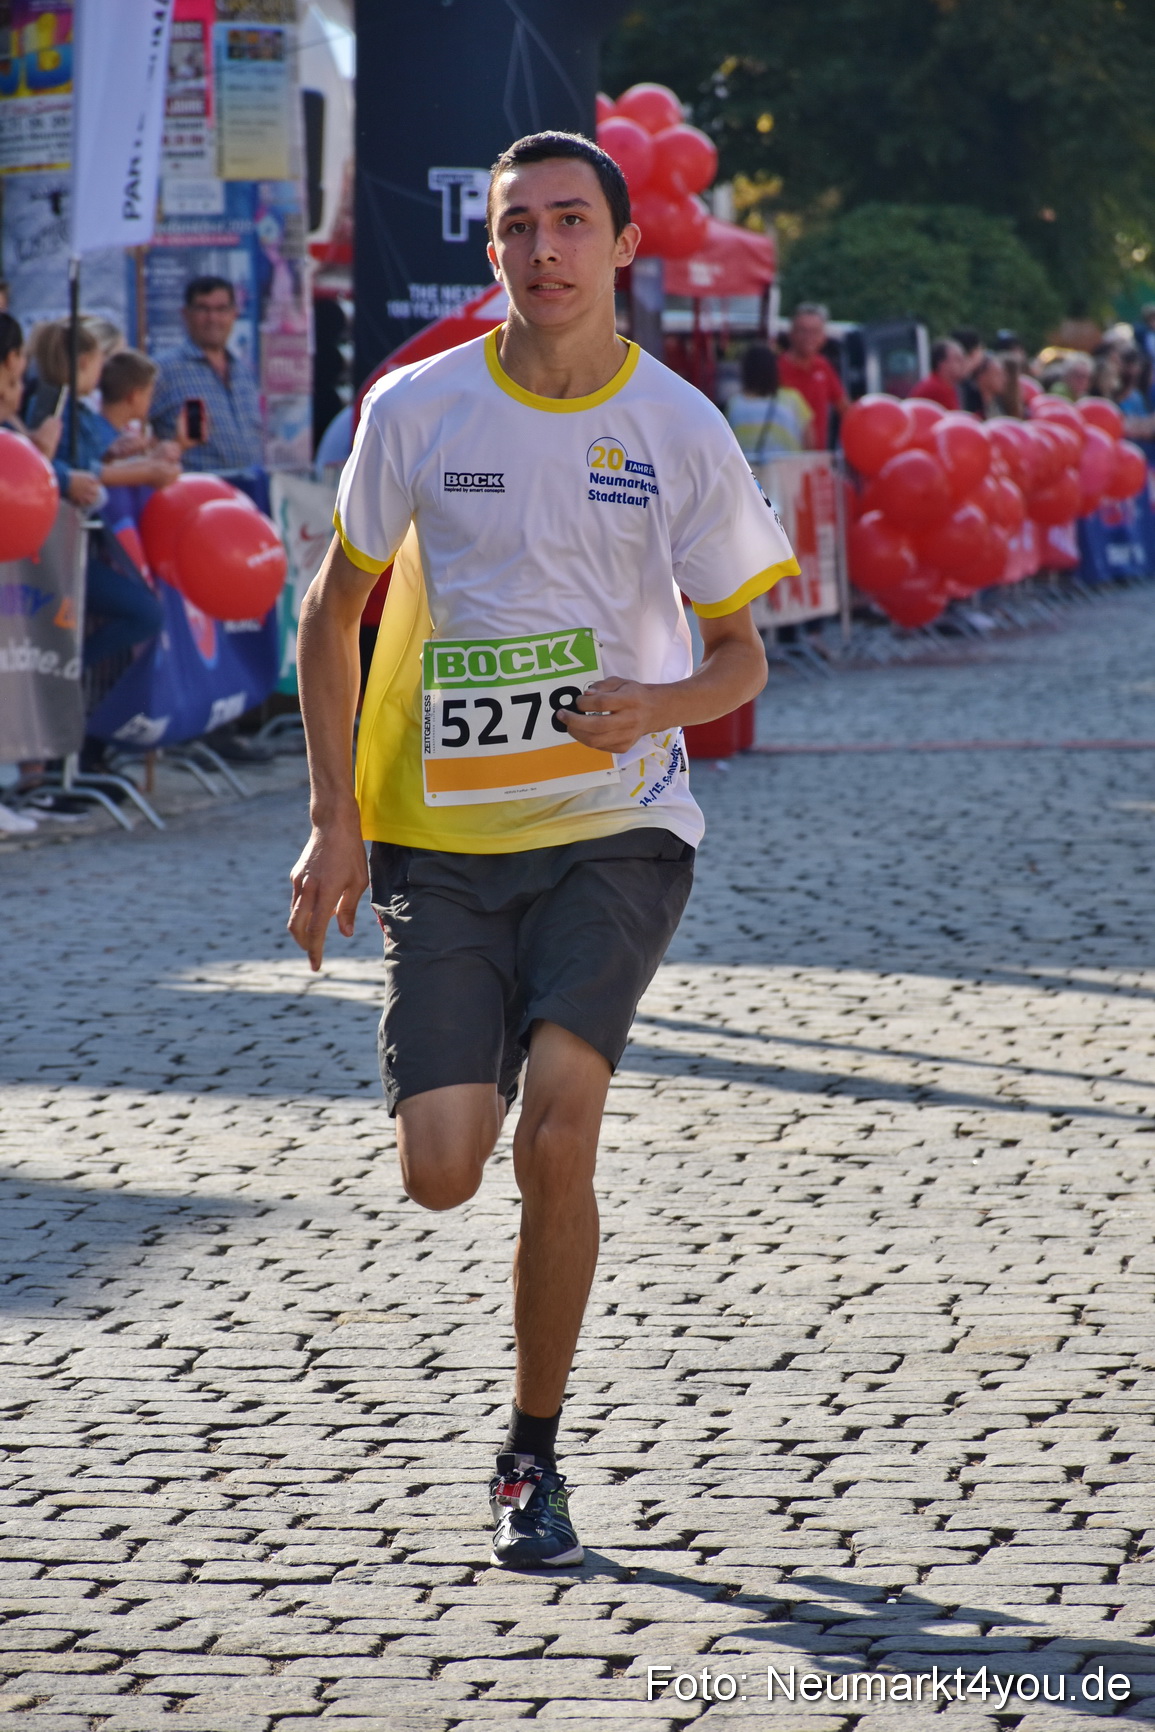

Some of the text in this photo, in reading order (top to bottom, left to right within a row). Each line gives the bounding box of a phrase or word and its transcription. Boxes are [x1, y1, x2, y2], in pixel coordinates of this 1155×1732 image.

[591, 445, 655, 475] 20 JAHRE
[444, 472, 505, 487] BOCK
[588, 489, 651, 509] Stadtlauf
[434, 634, 584, 683] BOCK
[441, 685, 586, 748] 5278
